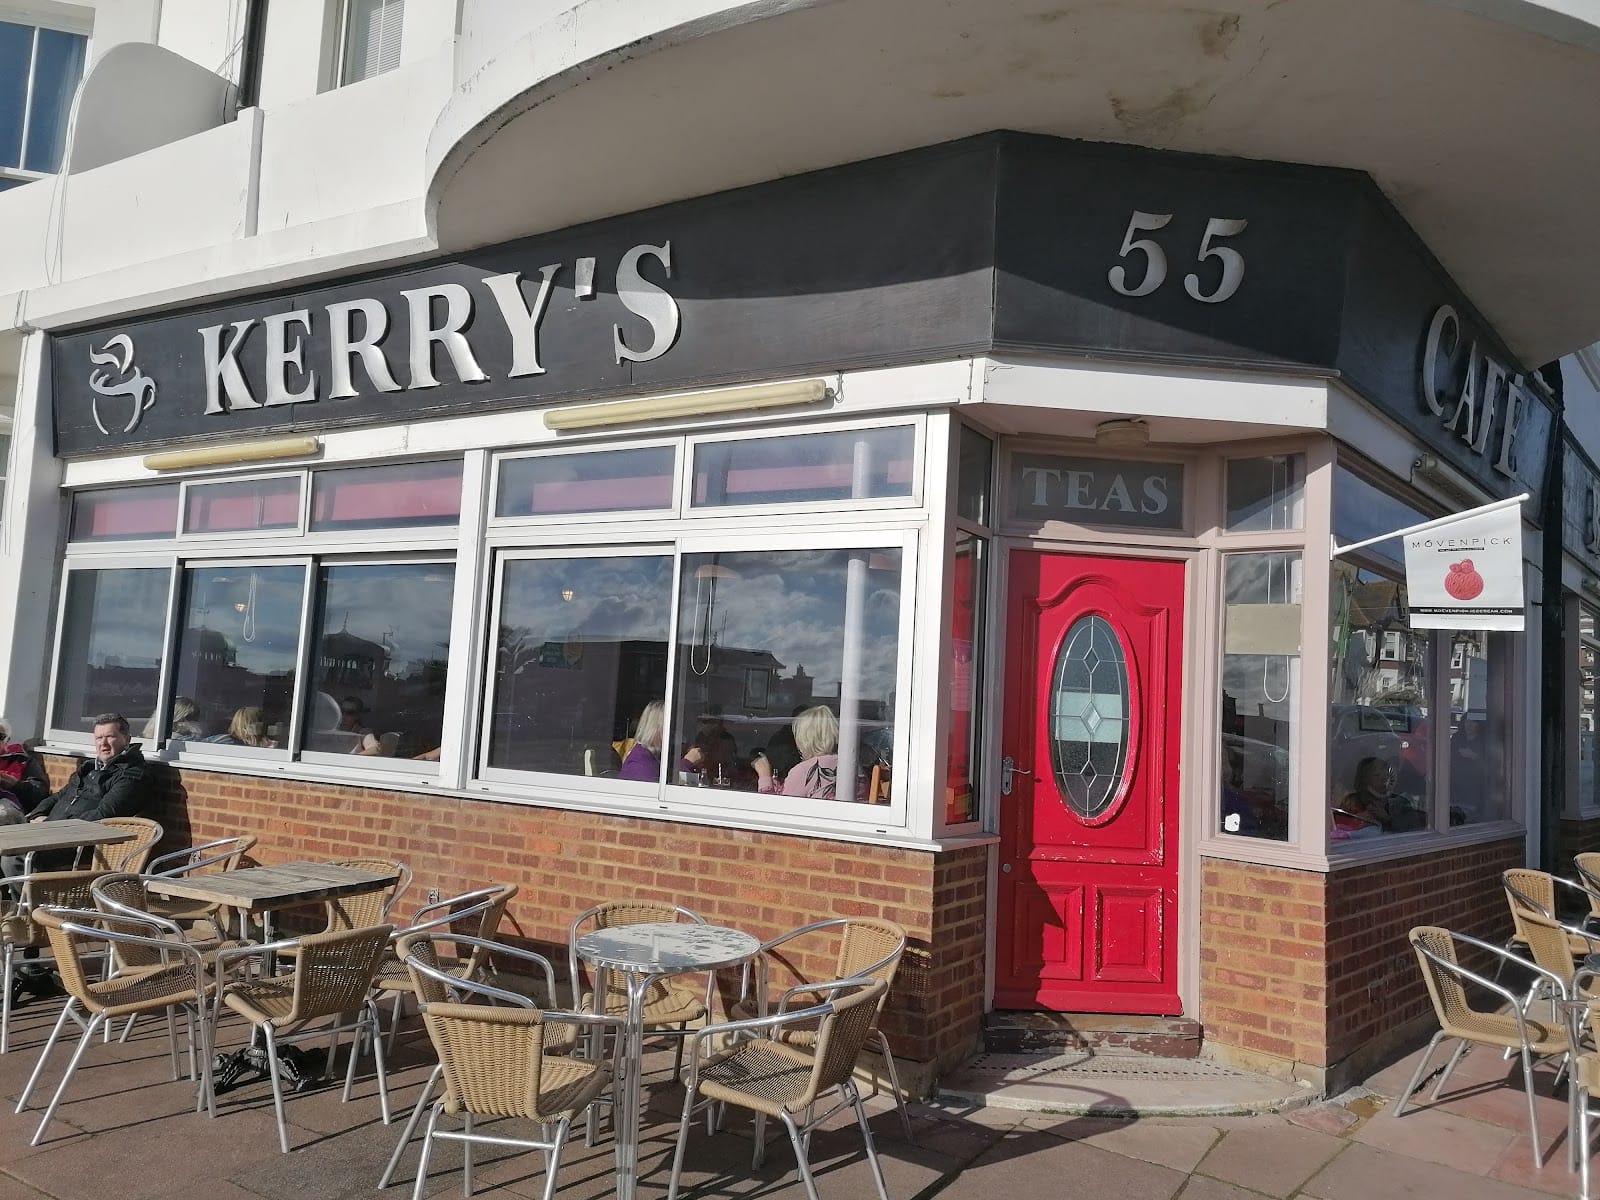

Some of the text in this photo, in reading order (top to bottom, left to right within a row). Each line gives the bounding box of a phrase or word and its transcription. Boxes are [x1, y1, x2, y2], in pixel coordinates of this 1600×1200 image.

[1108, 210, 1248, 303] 55
[198, 240, 680, 416] KERRY'S
[1022, 467, 1169, 514] TEAS
